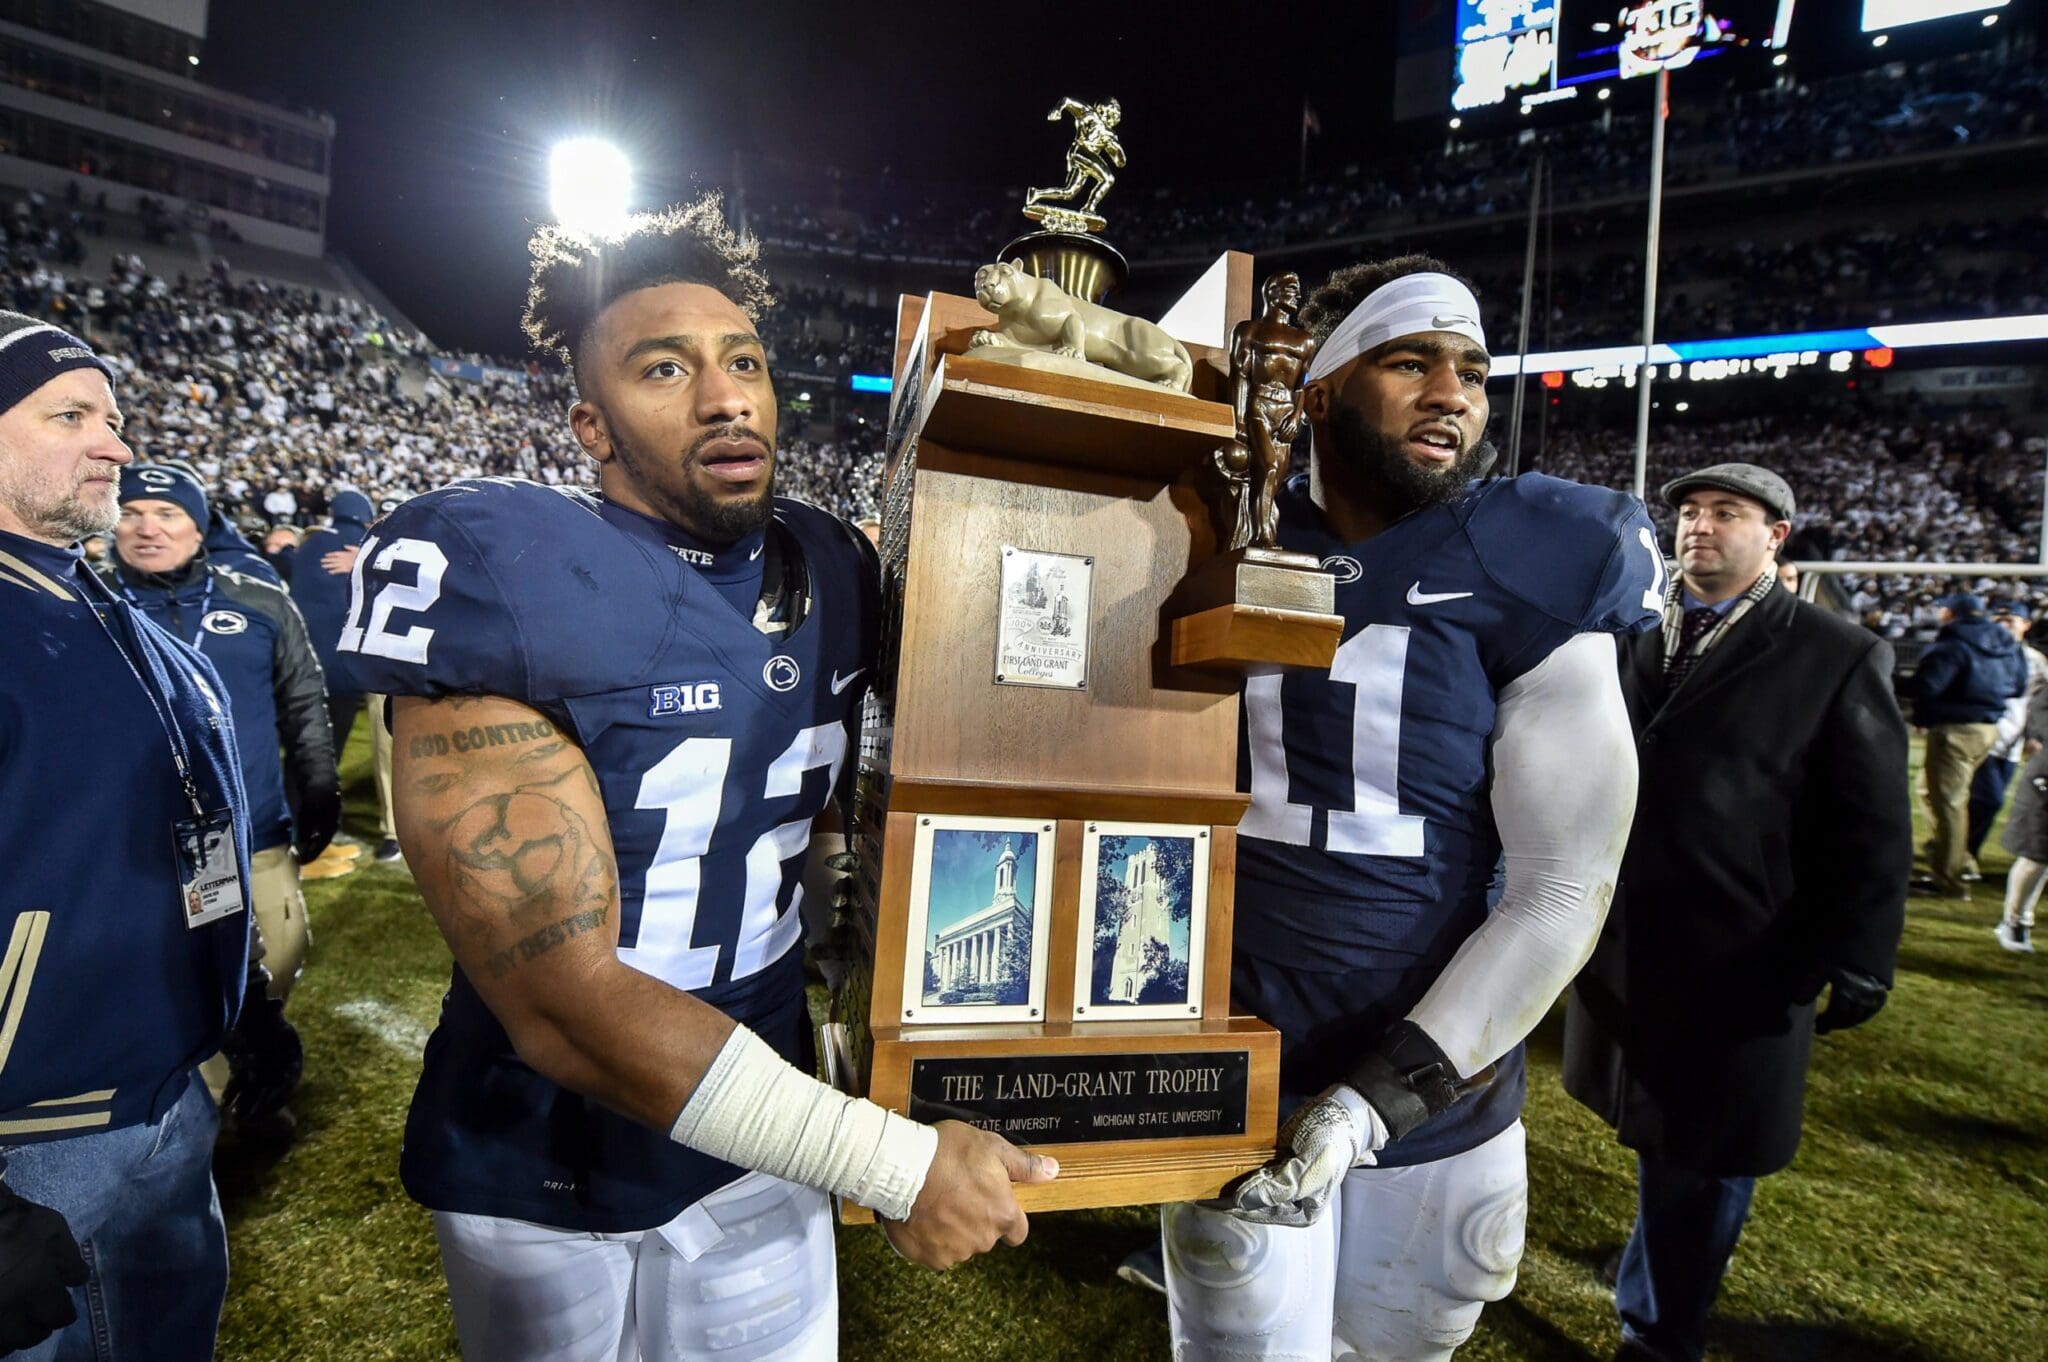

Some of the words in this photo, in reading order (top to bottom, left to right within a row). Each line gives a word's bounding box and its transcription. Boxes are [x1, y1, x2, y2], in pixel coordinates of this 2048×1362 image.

[336, 534, 449, 665] 12
[1017, 640, 1083, 660] ANNIVERSARY
[1043, 659, 1069, 671] GRANT
[452, 719, 554, 753] CONTRO
[1236, 623, 1426, 857] 11
[616, 720, 848, 991] 12
[942, 1074, 984, 1101] THE
[995, 1071, 1136, 1099] LAND-GRANT
[1145, 1067, 1224, 1095] TROPHY
[1005, 1116, 1061, 1131] UNIVERSITY
[1092, 1113, 1136, 1127] MICHIGAN
[1138, 1111, 1169, 1125] STATE
[1172, 1109, 1223, 1124] UNIVERSITY
